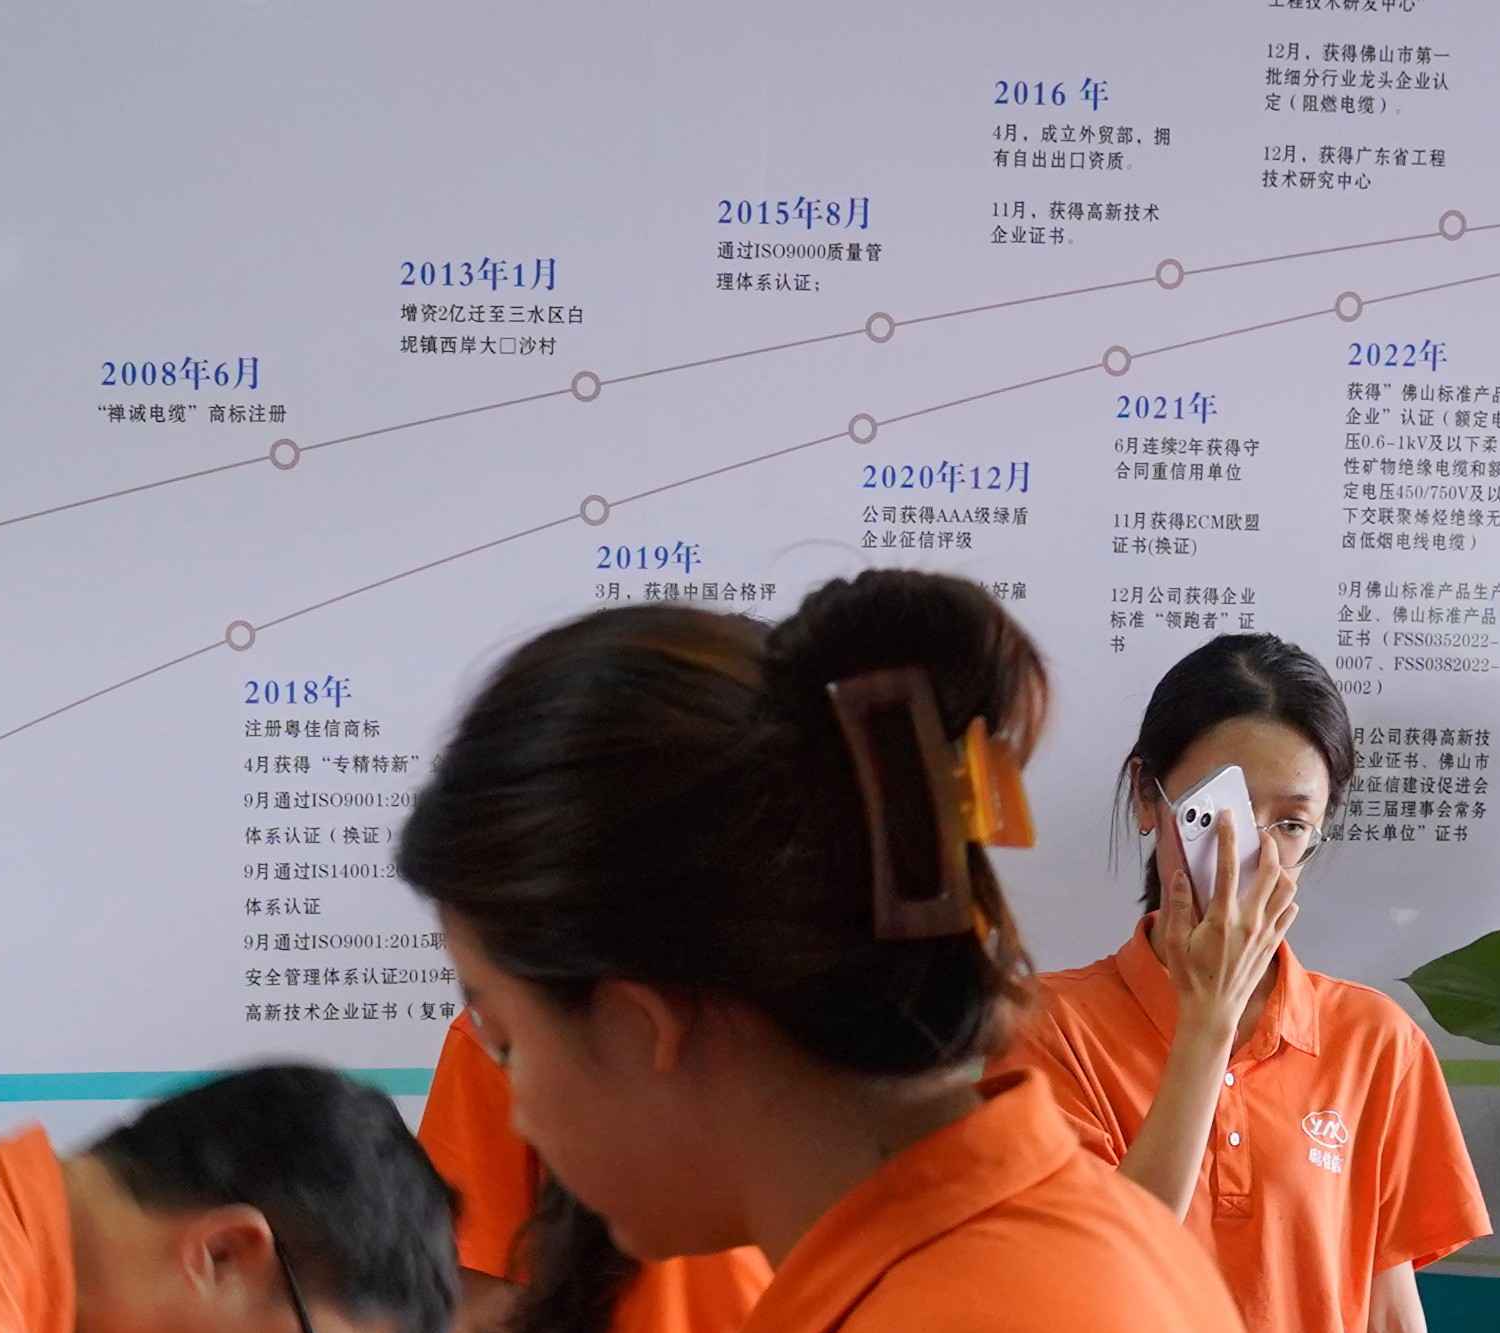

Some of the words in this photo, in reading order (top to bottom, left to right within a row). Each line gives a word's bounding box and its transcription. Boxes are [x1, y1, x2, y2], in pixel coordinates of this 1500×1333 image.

[1265, 67, 1449, 90] 批细分行业龙头企业认
[1262, 169, 1371, 191] 技术研究中心
[717, 196, 871, 231] 2015年8月
[716, 241, 882, 263] 通过ISO9000质量管
[400, 256, 558, 291] 2013年1月
[400, 303, 584, 326] 增资2亿迁至三水区白
[1348, 339, 1447, 372] 2022年
[100, 356, 262, 391] 2008年6月
[1116, 392, 1217, 424] 2021年
[1114, 437, 1260, 457] 6月连续2年获得守
[862, 460, 1031, 493] 2020年12月
[1115, 461, 1243, 482] 合同重信用单位
[862, 505, 1029, 526] 公司获得AAA级绿盾
[861, 530, 972, 550] 企业征信评级
[596, 541, 701, 574] 2019年
[1111, 586, 1256, 606] 12月公司获得企业
[1110, 634, 1125, 653] 书
[244, 675, 352, 708] 2018年
[244, 719, 381, 739] 注册粤佳信商标
[245, 898, 321, 916] 体系认证
[245, 968, 456, 987] 安全管理体系认证2019年
